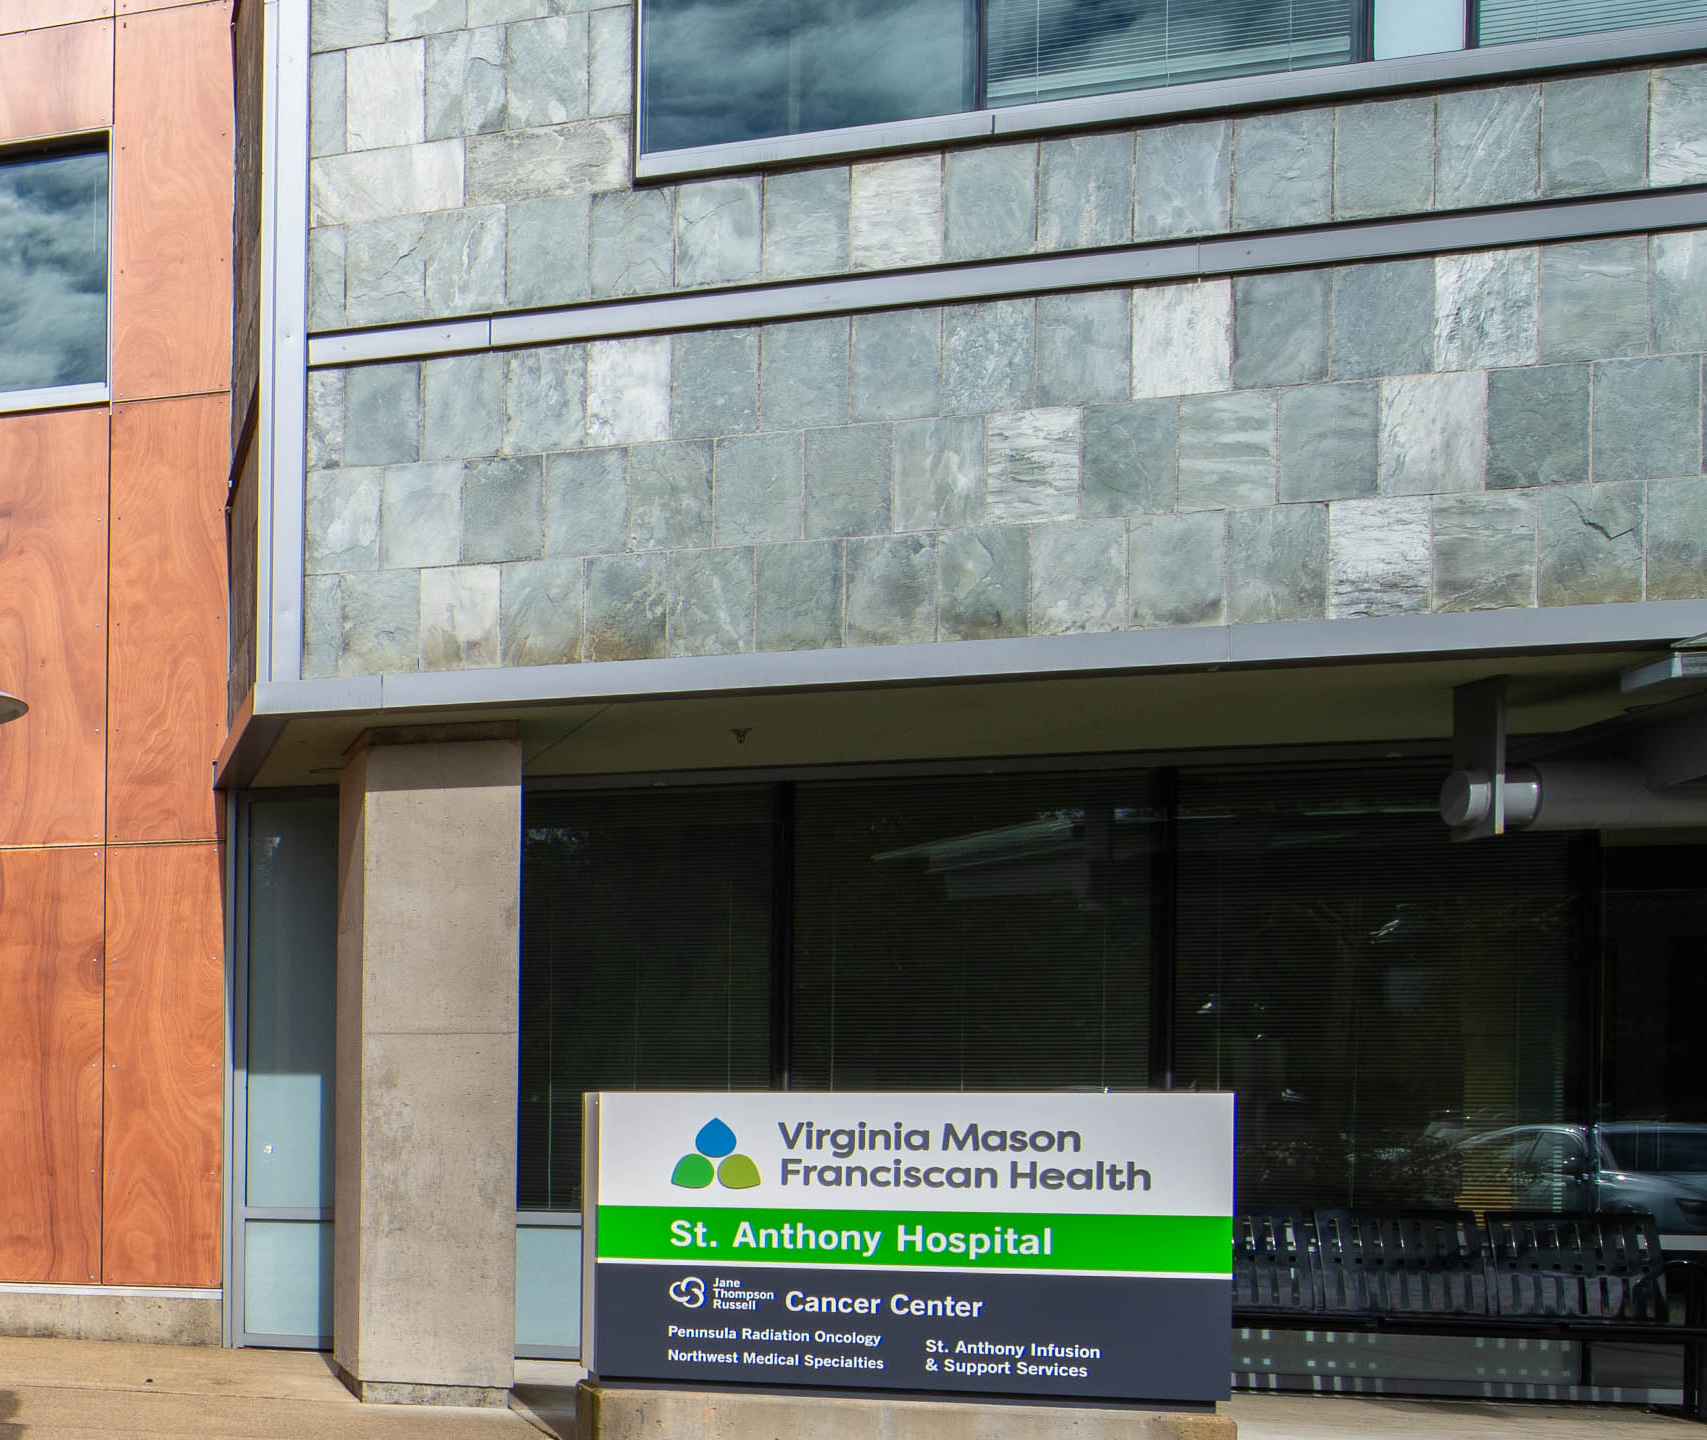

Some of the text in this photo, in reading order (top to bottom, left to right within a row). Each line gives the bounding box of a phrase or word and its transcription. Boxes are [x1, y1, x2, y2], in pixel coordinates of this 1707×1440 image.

[777, 1120, 1082, 1158] Virginia Mason
[779, 1156, 1152, 1192] Franciscan Health
[669, 1219, 1053, 1260] St. Anthony Hospital
[712, 1277, 742, 1289] Jane
[712, 1288, 775, 1303] Thompson
[712, 1299, 756, 1311] Russell
[784, 1289, 984, 1319] Cancer Center
[668, 1325, 882, 1348] Peninsula Radiation Oncology
[925, 1337, 1101, 1360] St. Anthony Infusion
[667, 1350, 885, 1372] Northwest Medical Specialties
[925, 1359, 1089, 1379] & Support Services
